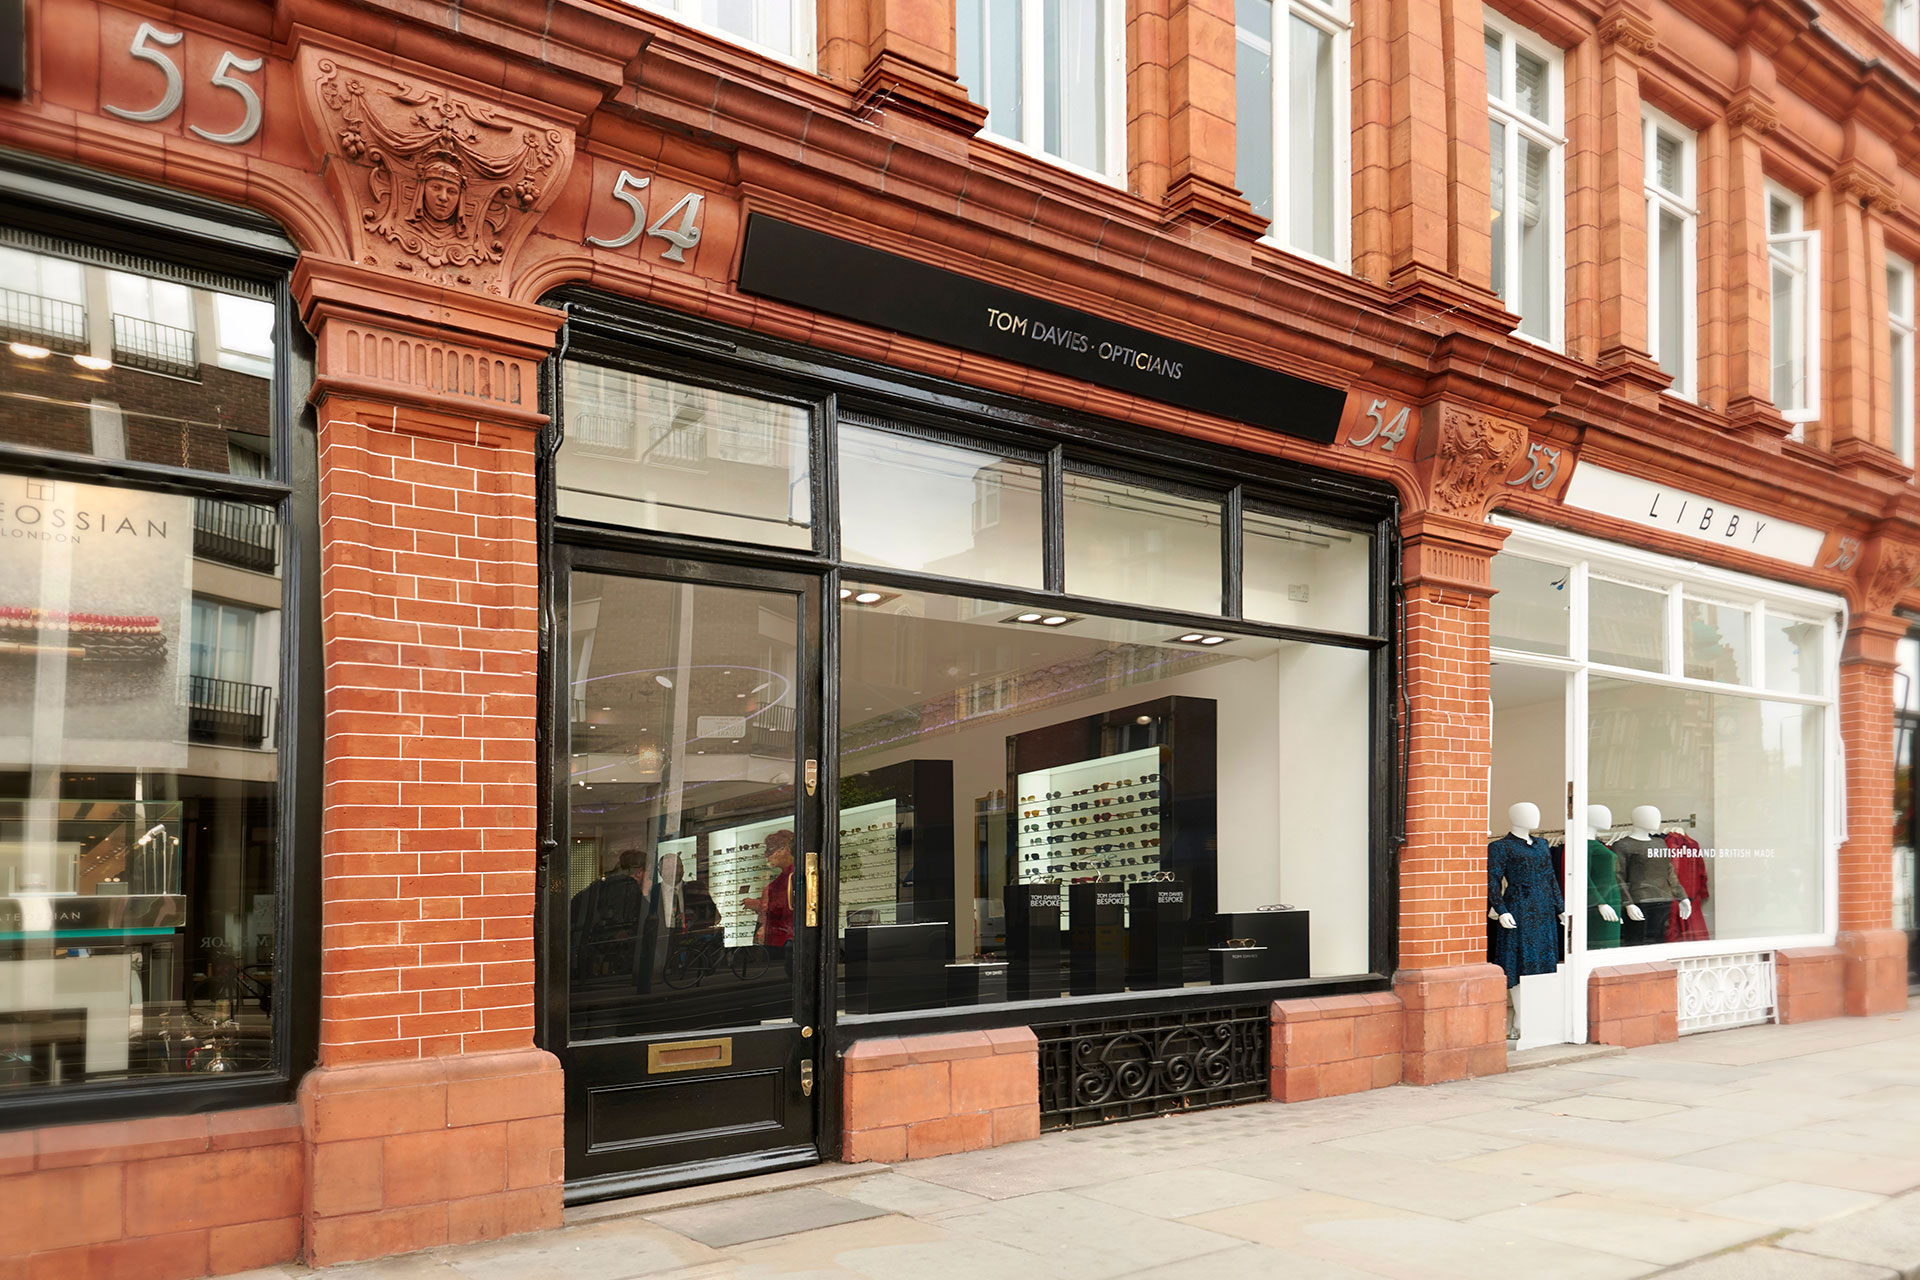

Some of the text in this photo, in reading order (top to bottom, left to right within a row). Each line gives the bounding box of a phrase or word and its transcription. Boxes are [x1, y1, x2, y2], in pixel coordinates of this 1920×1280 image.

[103, 22, 264, 144] 55
[586, 169, 705, 263] 54
[987, 308, 1184, 380] TOM DAVIES OPTICIANS
[1347, 398, 1411, 451] 54
[1505, 442, 1561, 490] 53
[1, 527, 81, 544] LONDON
[1649, 492, 1767, 544] LIBBY
[1823, 535, 1861, 571] 53
[1647, 847, 1776, 859] BRITISH BRAND BRITISH MADE
[1030, 899, 1061, 907] BESPOKE
[1096, 898, 1125, 906] BESPOKE
[1158, 896, 1184, 904] BESPOKE
